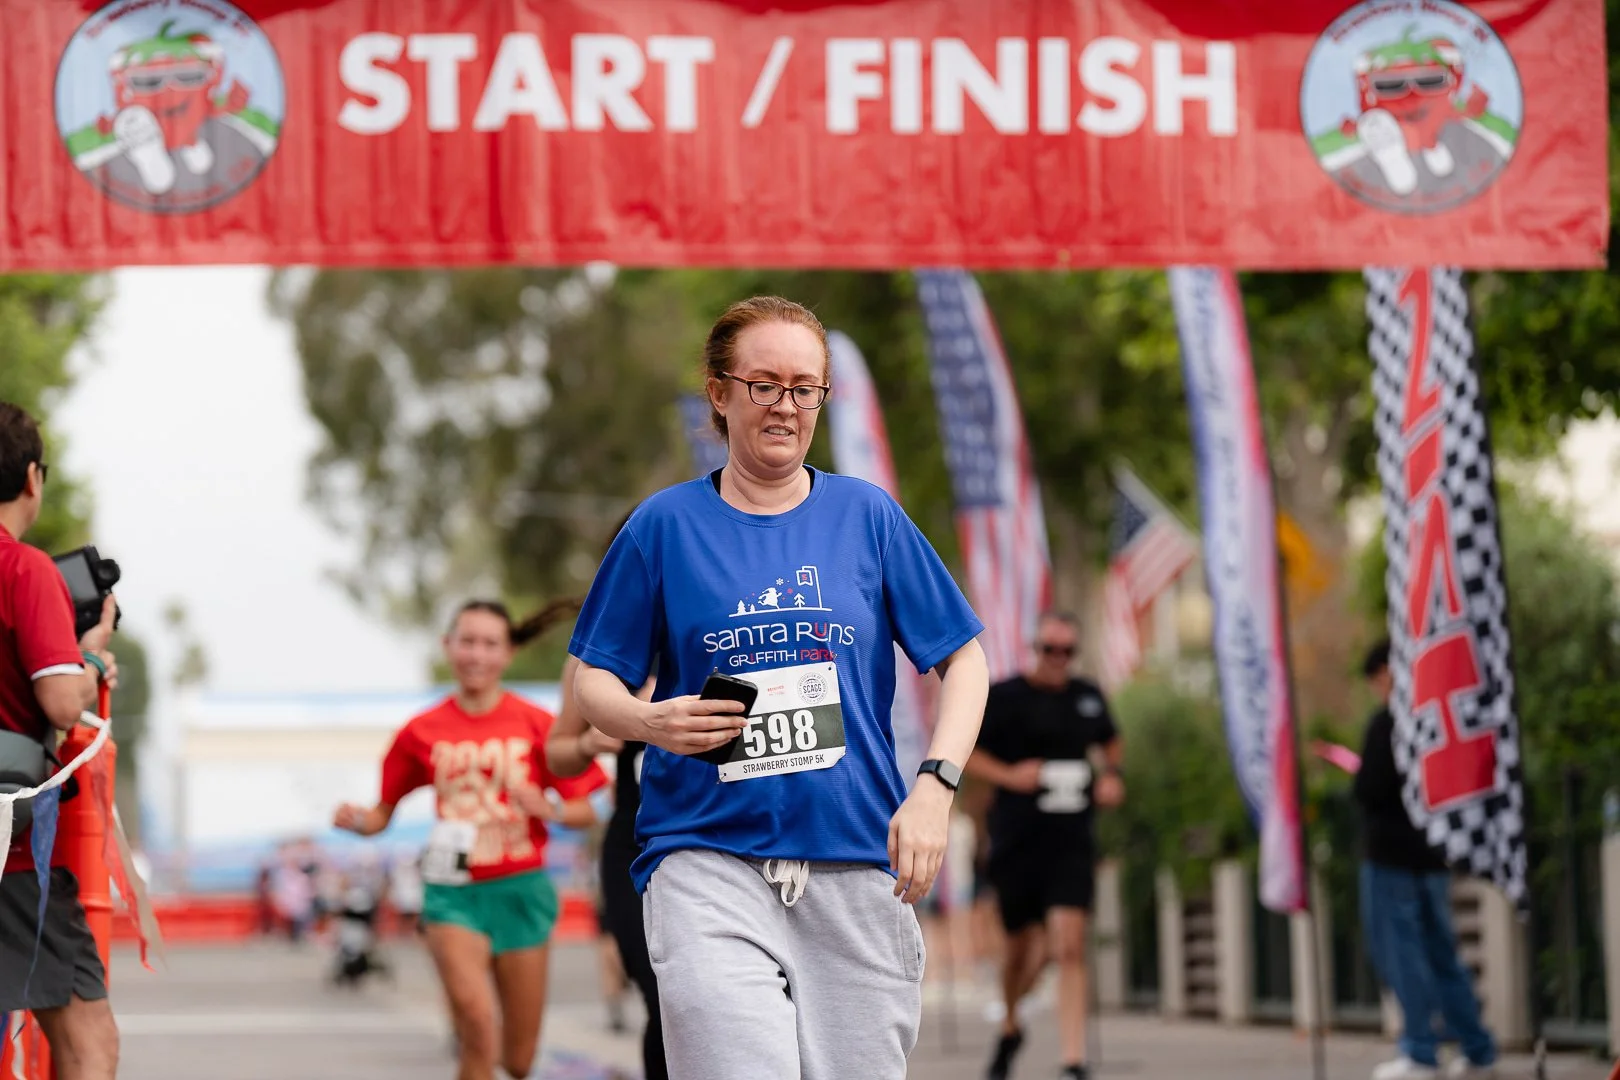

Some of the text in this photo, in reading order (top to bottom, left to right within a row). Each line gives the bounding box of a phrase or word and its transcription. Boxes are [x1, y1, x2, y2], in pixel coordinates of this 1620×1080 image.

[338, 31, 1238, 137] START / FINISH
[728, 649, 797, 667] GRIFFITH
[742, 709, 818, 758] 598
[742, 754, 825, 774] STRAWBERRY STOMP 5K
